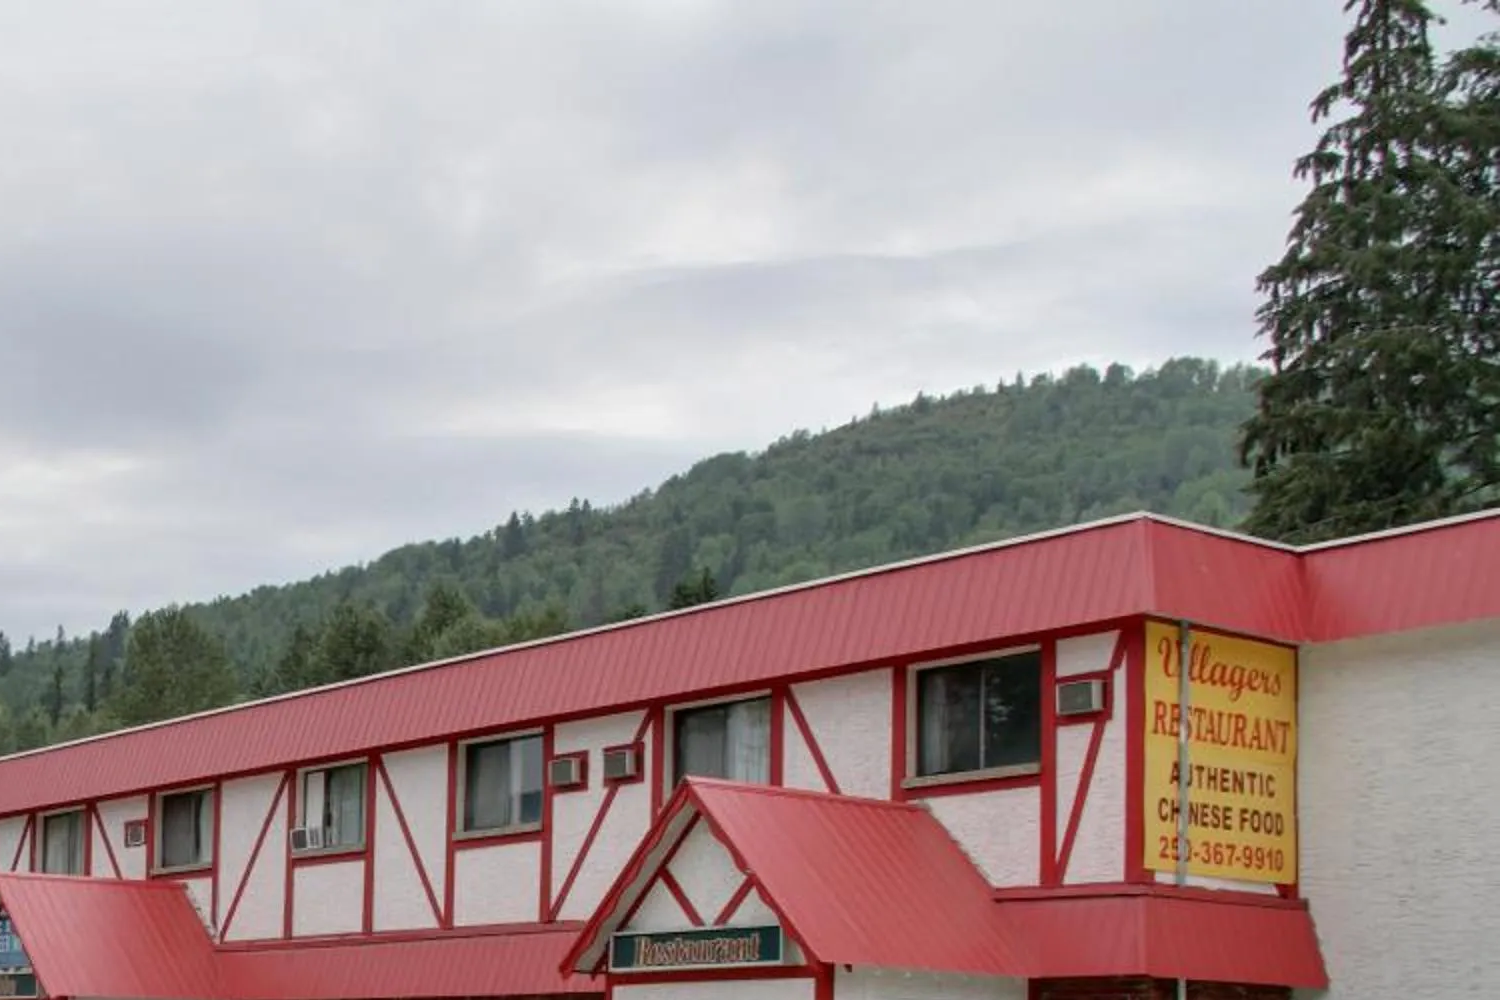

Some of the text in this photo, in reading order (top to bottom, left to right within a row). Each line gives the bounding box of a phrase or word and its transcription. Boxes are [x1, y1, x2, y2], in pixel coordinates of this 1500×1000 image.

[1157, 636, 1282, 701] Vllagers
[1157, 797, 1285, 837] CHNESE FOOD
[635, 932, 761, 967] Restaurant
